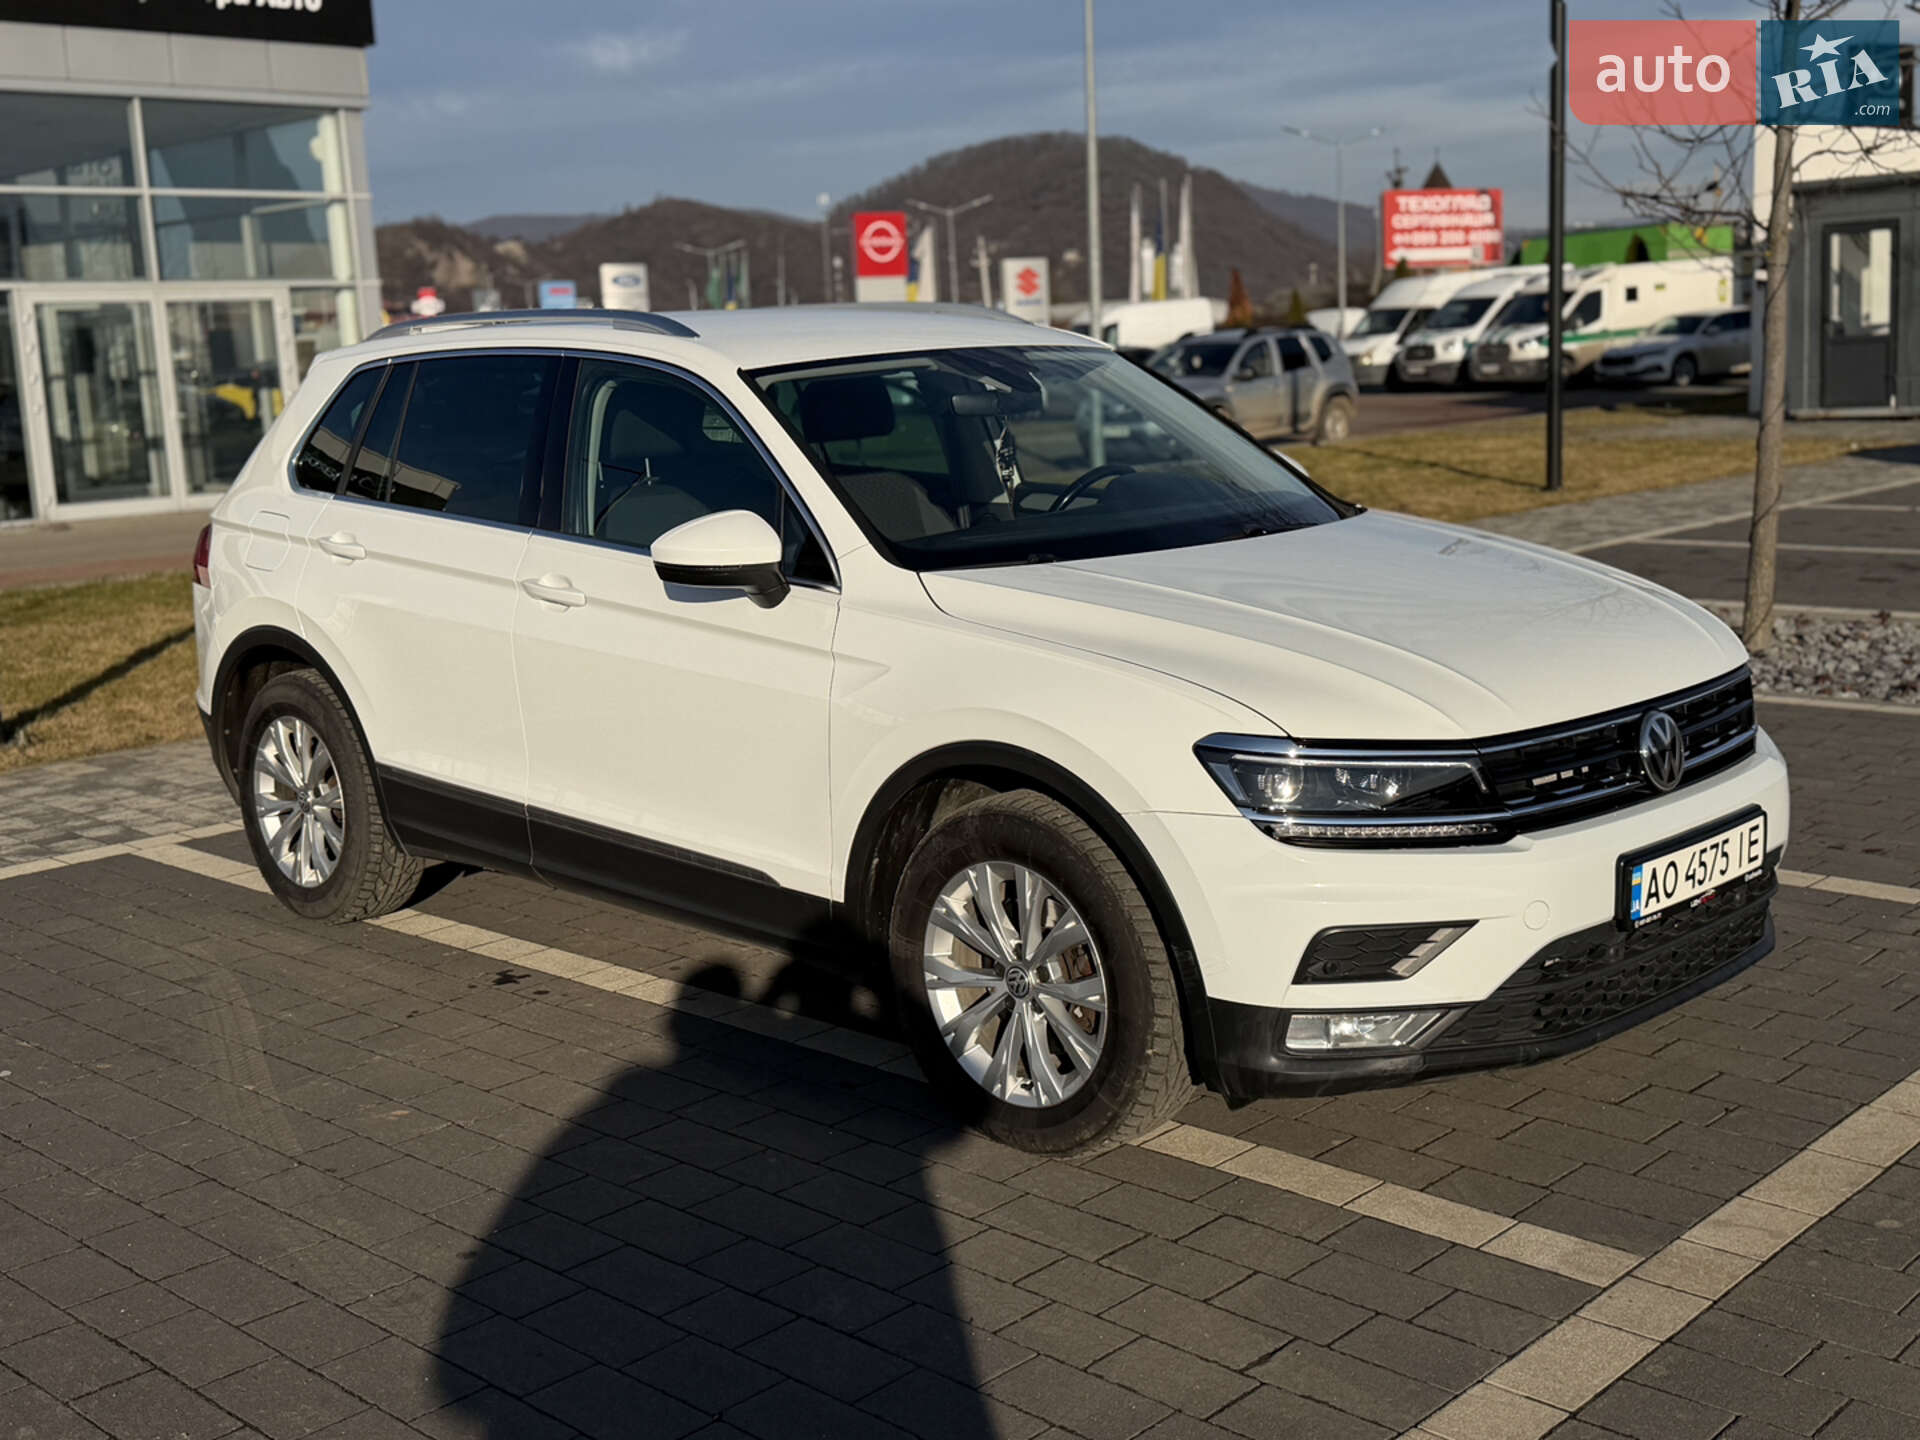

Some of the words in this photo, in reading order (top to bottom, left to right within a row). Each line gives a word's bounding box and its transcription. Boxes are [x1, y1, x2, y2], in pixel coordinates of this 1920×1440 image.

[1645, 860, 1679, 909] AO
[1685, 837, 1730, 889] 4575
[1738, 823, 1760, 869] IE
